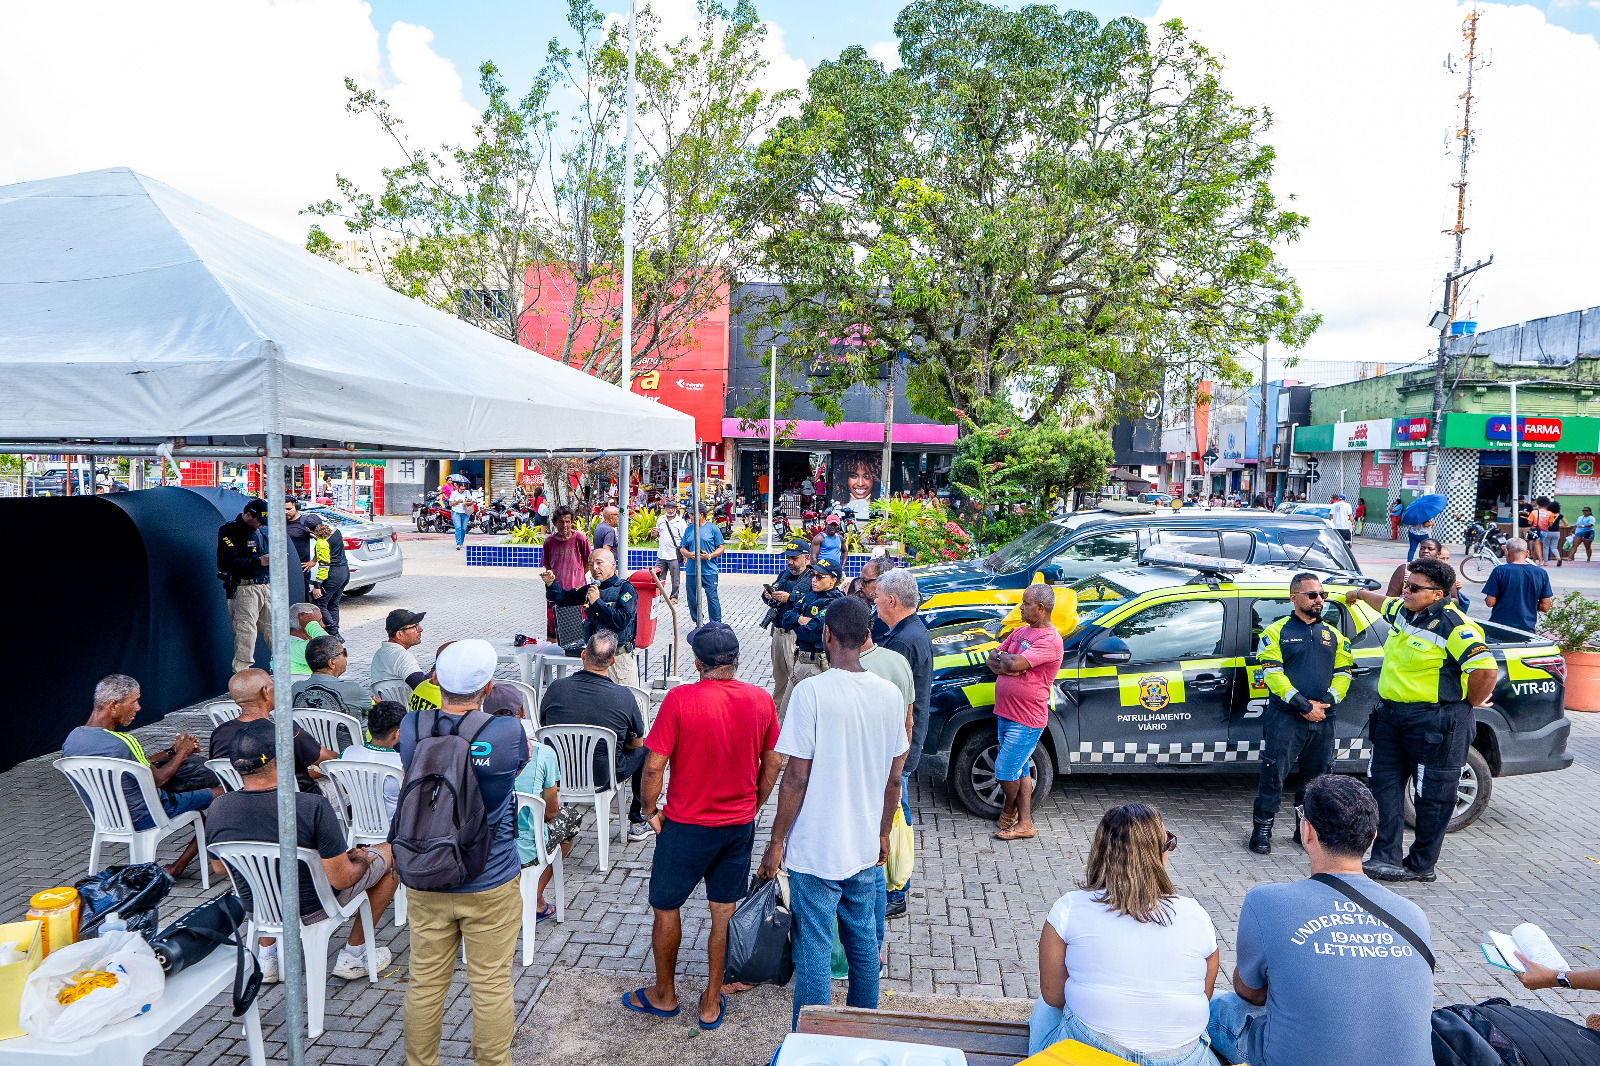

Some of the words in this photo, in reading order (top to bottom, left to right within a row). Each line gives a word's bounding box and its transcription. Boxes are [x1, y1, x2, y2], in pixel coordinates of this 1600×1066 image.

[1511, 682, 1556, 696] VTR-03
[1117, 712, 1192, 722] PATRULHAMENTO
[1138, 722, 1167, 731] VIÁRIO
[1313, 942, 1388, 958] LETTING
[1390, 945, 1413, 957] GO
